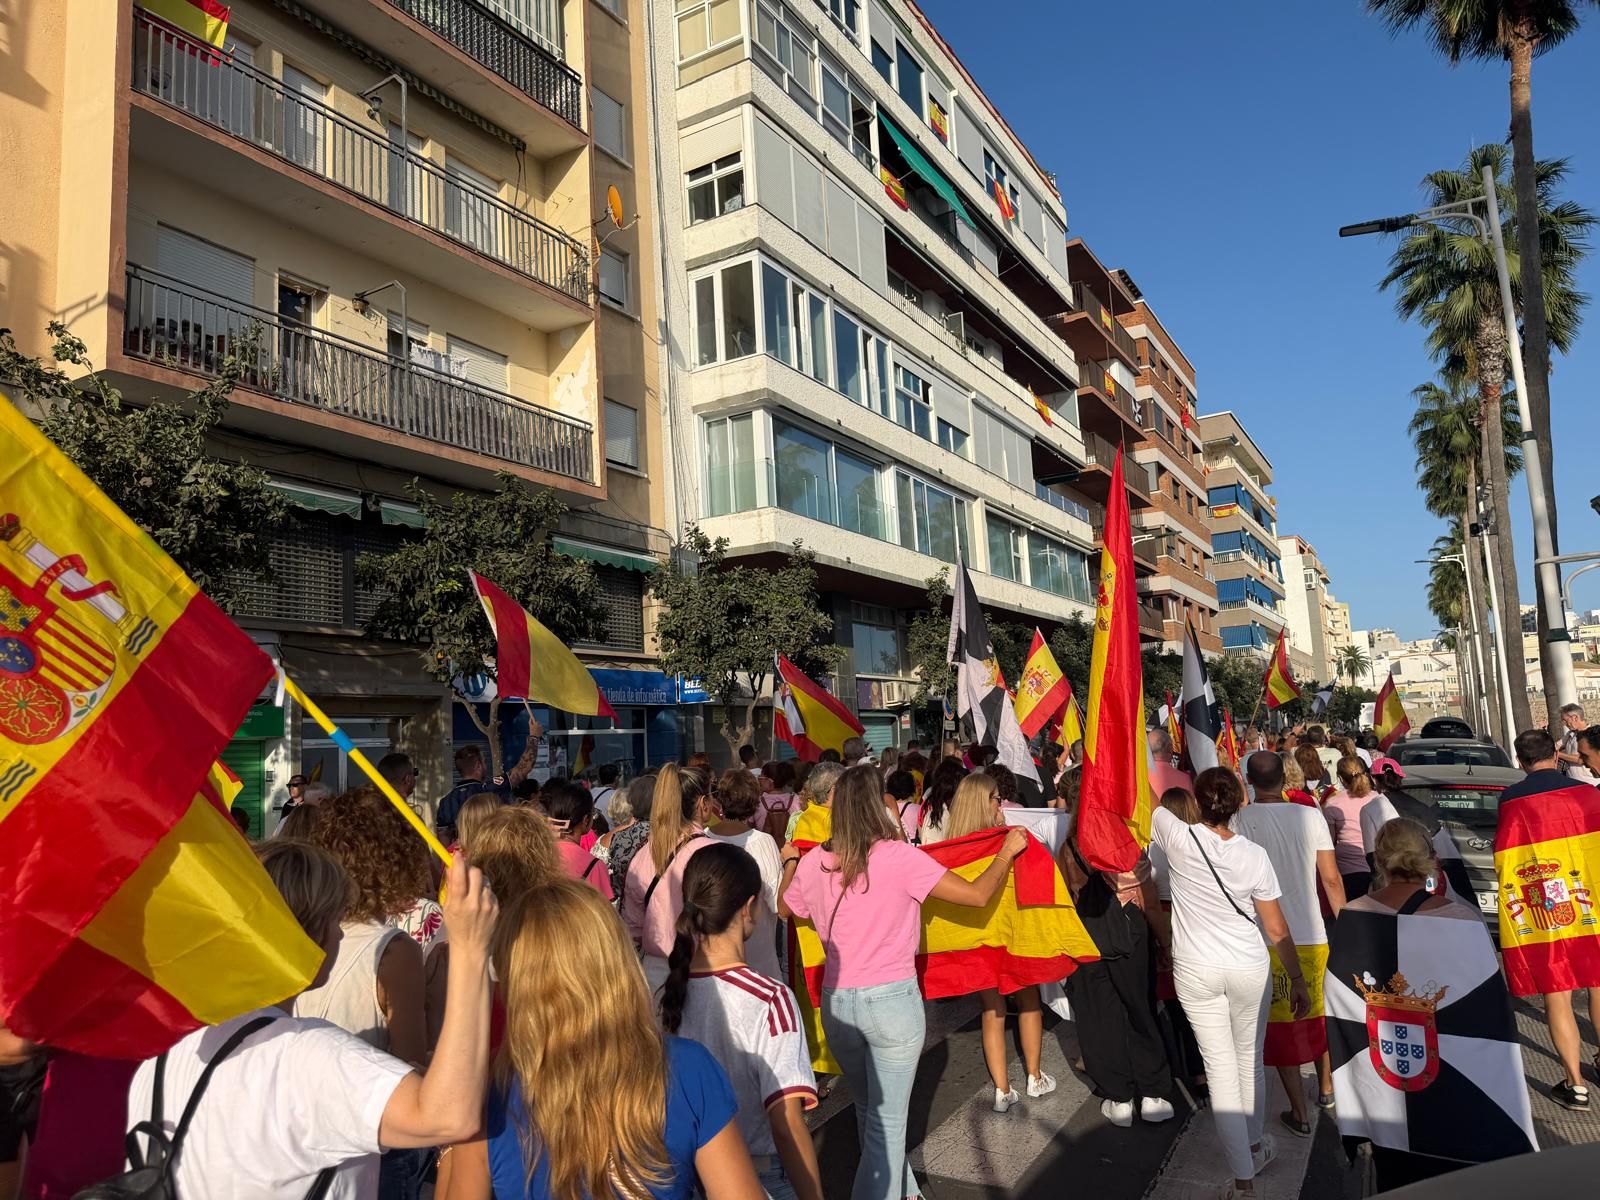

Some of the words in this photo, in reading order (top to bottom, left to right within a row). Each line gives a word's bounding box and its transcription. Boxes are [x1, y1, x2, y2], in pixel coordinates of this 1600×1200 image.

[684, 679, 702, 689] BEE
[627, 686, 635, 702] de
[1480, 894, 1488, 905] 5
